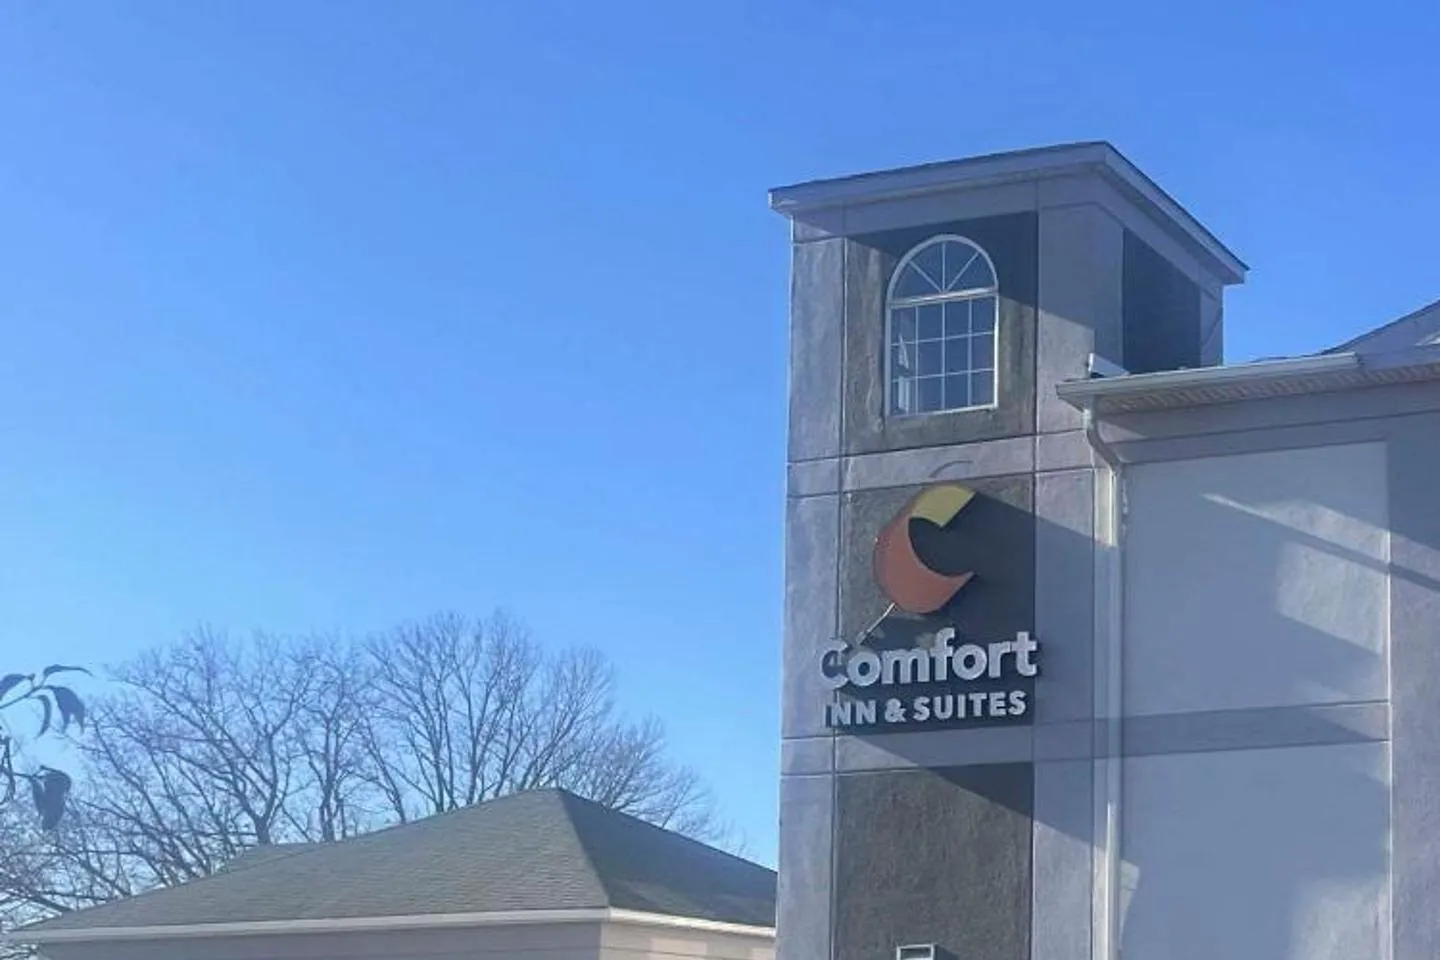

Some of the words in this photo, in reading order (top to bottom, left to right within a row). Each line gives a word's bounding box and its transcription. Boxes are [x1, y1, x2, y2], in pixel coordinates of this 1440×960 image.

[820, 627, 1038, 689] Comfort
[822, 700, 876, 726] INN
[884, 698, 907, 723] &
[913, 690, 1026, 721] SUITES
